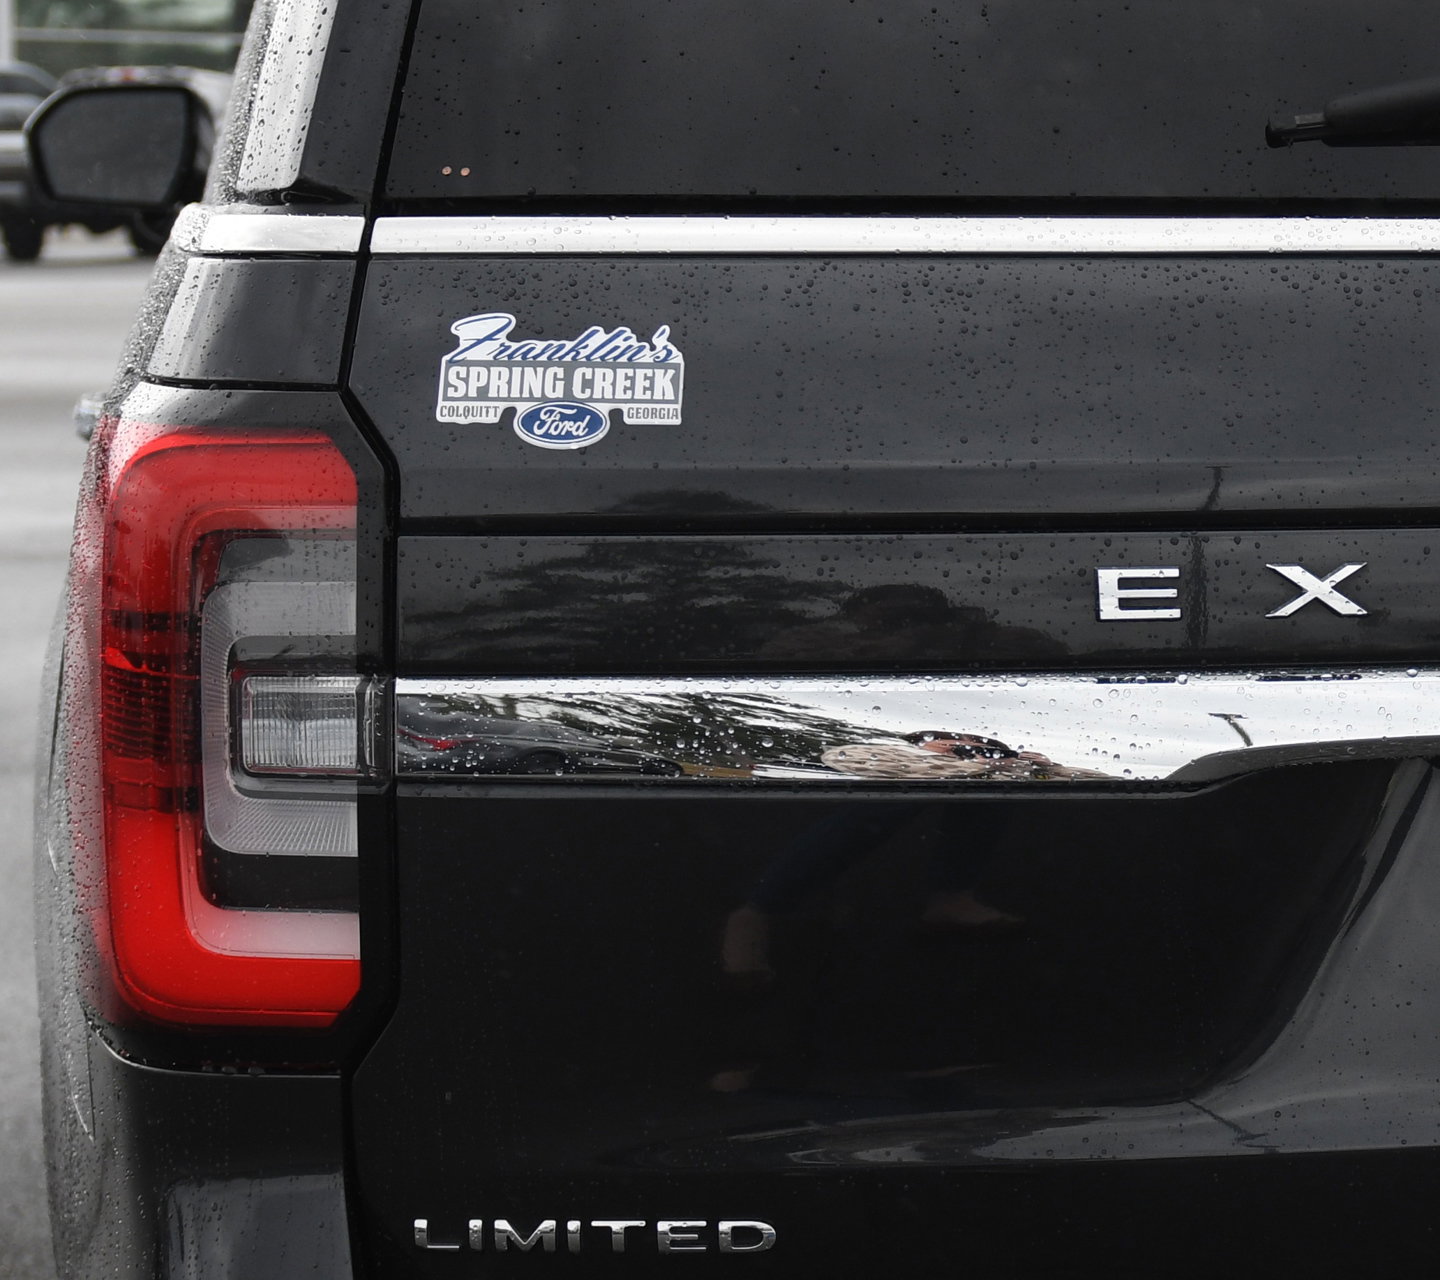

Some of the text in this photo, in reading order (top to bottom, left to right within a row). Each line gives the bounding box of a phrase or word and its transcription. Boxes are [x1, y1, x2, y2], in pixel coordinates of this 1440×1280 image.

[448, 315, 680, 365] Franklin's
[446, 365, 676, 401] SPRING CREEK
[439, 404, 501, 419] COLQUITT
[533, 406, 590, 438] Ford
[626, 405, 680, 421] GEORGIA
[413, 1218, 778, 1254] LIMITED
